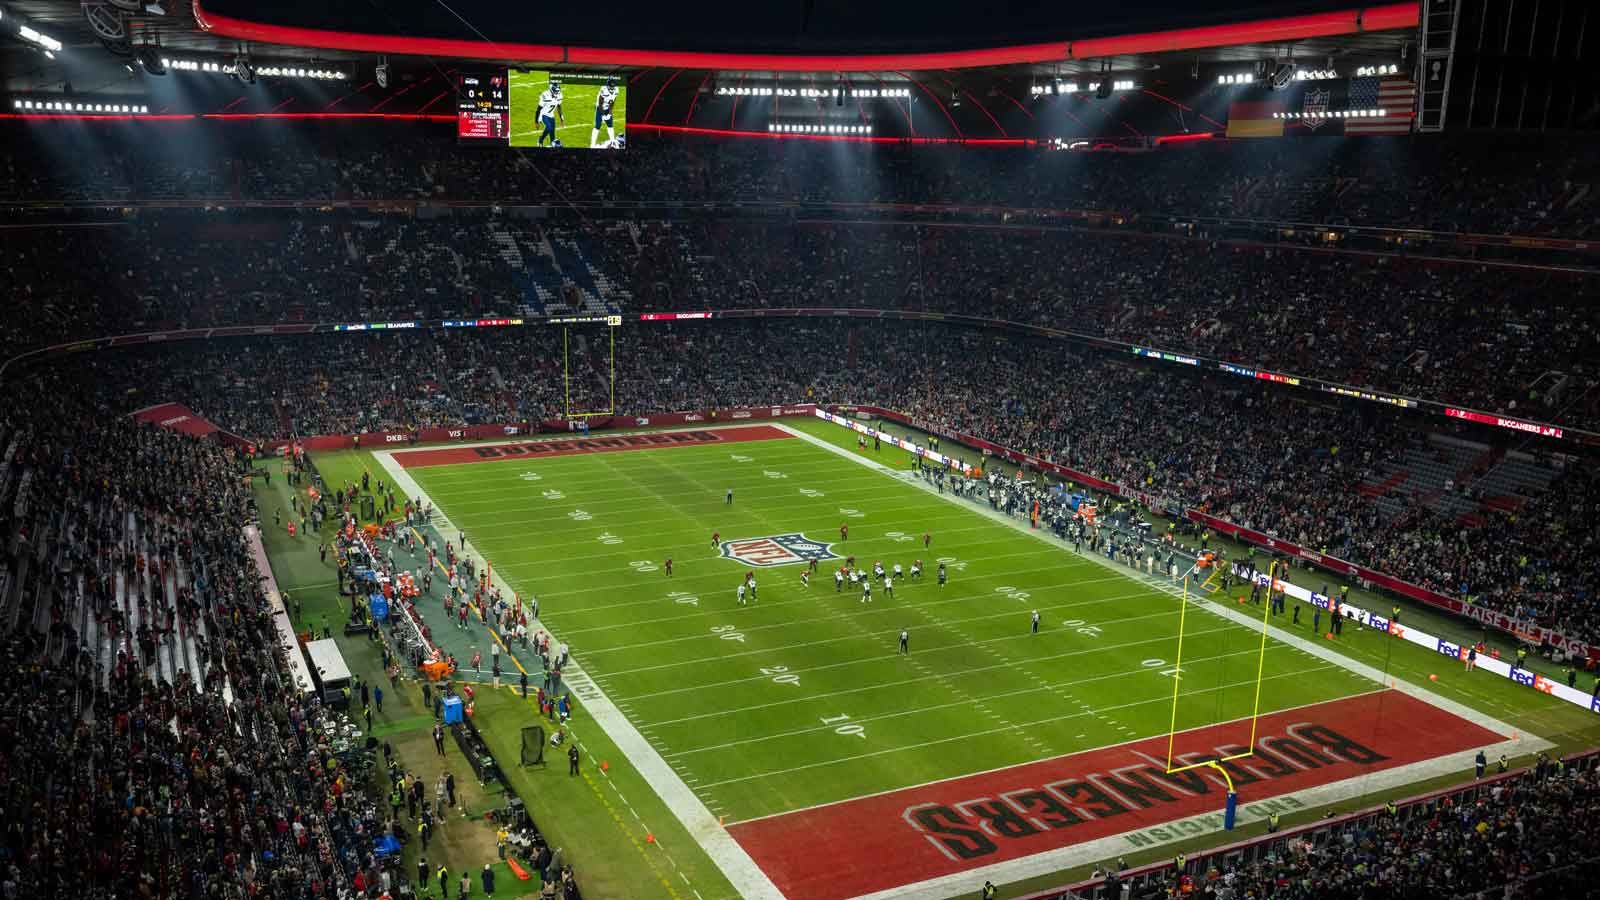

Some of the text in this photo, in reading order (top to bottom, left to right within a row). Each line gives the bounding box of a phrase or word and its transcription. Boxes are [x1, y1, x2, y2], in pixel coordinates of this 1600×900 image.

[469, 89, 475, 98] 0
[492, 90, 502, 99] 14
[1497, 418, 1541, 434] BUCCANEERS
[730, 539, 797, 564] NFL
[667, 591, 699, 604] 40
[710, 625, 745, 640] 30
[1369, 612, 1405, 639] FedEx
[1460, 602, 1590, 657] RAISE THE FLAGS
[1438, 639, 1476, 667] FedE
[759, 665, 799, 684] 20
[1509, 664, 1553, 695] FedEx
[820, 712, 865, 736] 10
[902, 721, 1392, 863] BUCCANEERS
[1247, 795, 1304, 816] END
